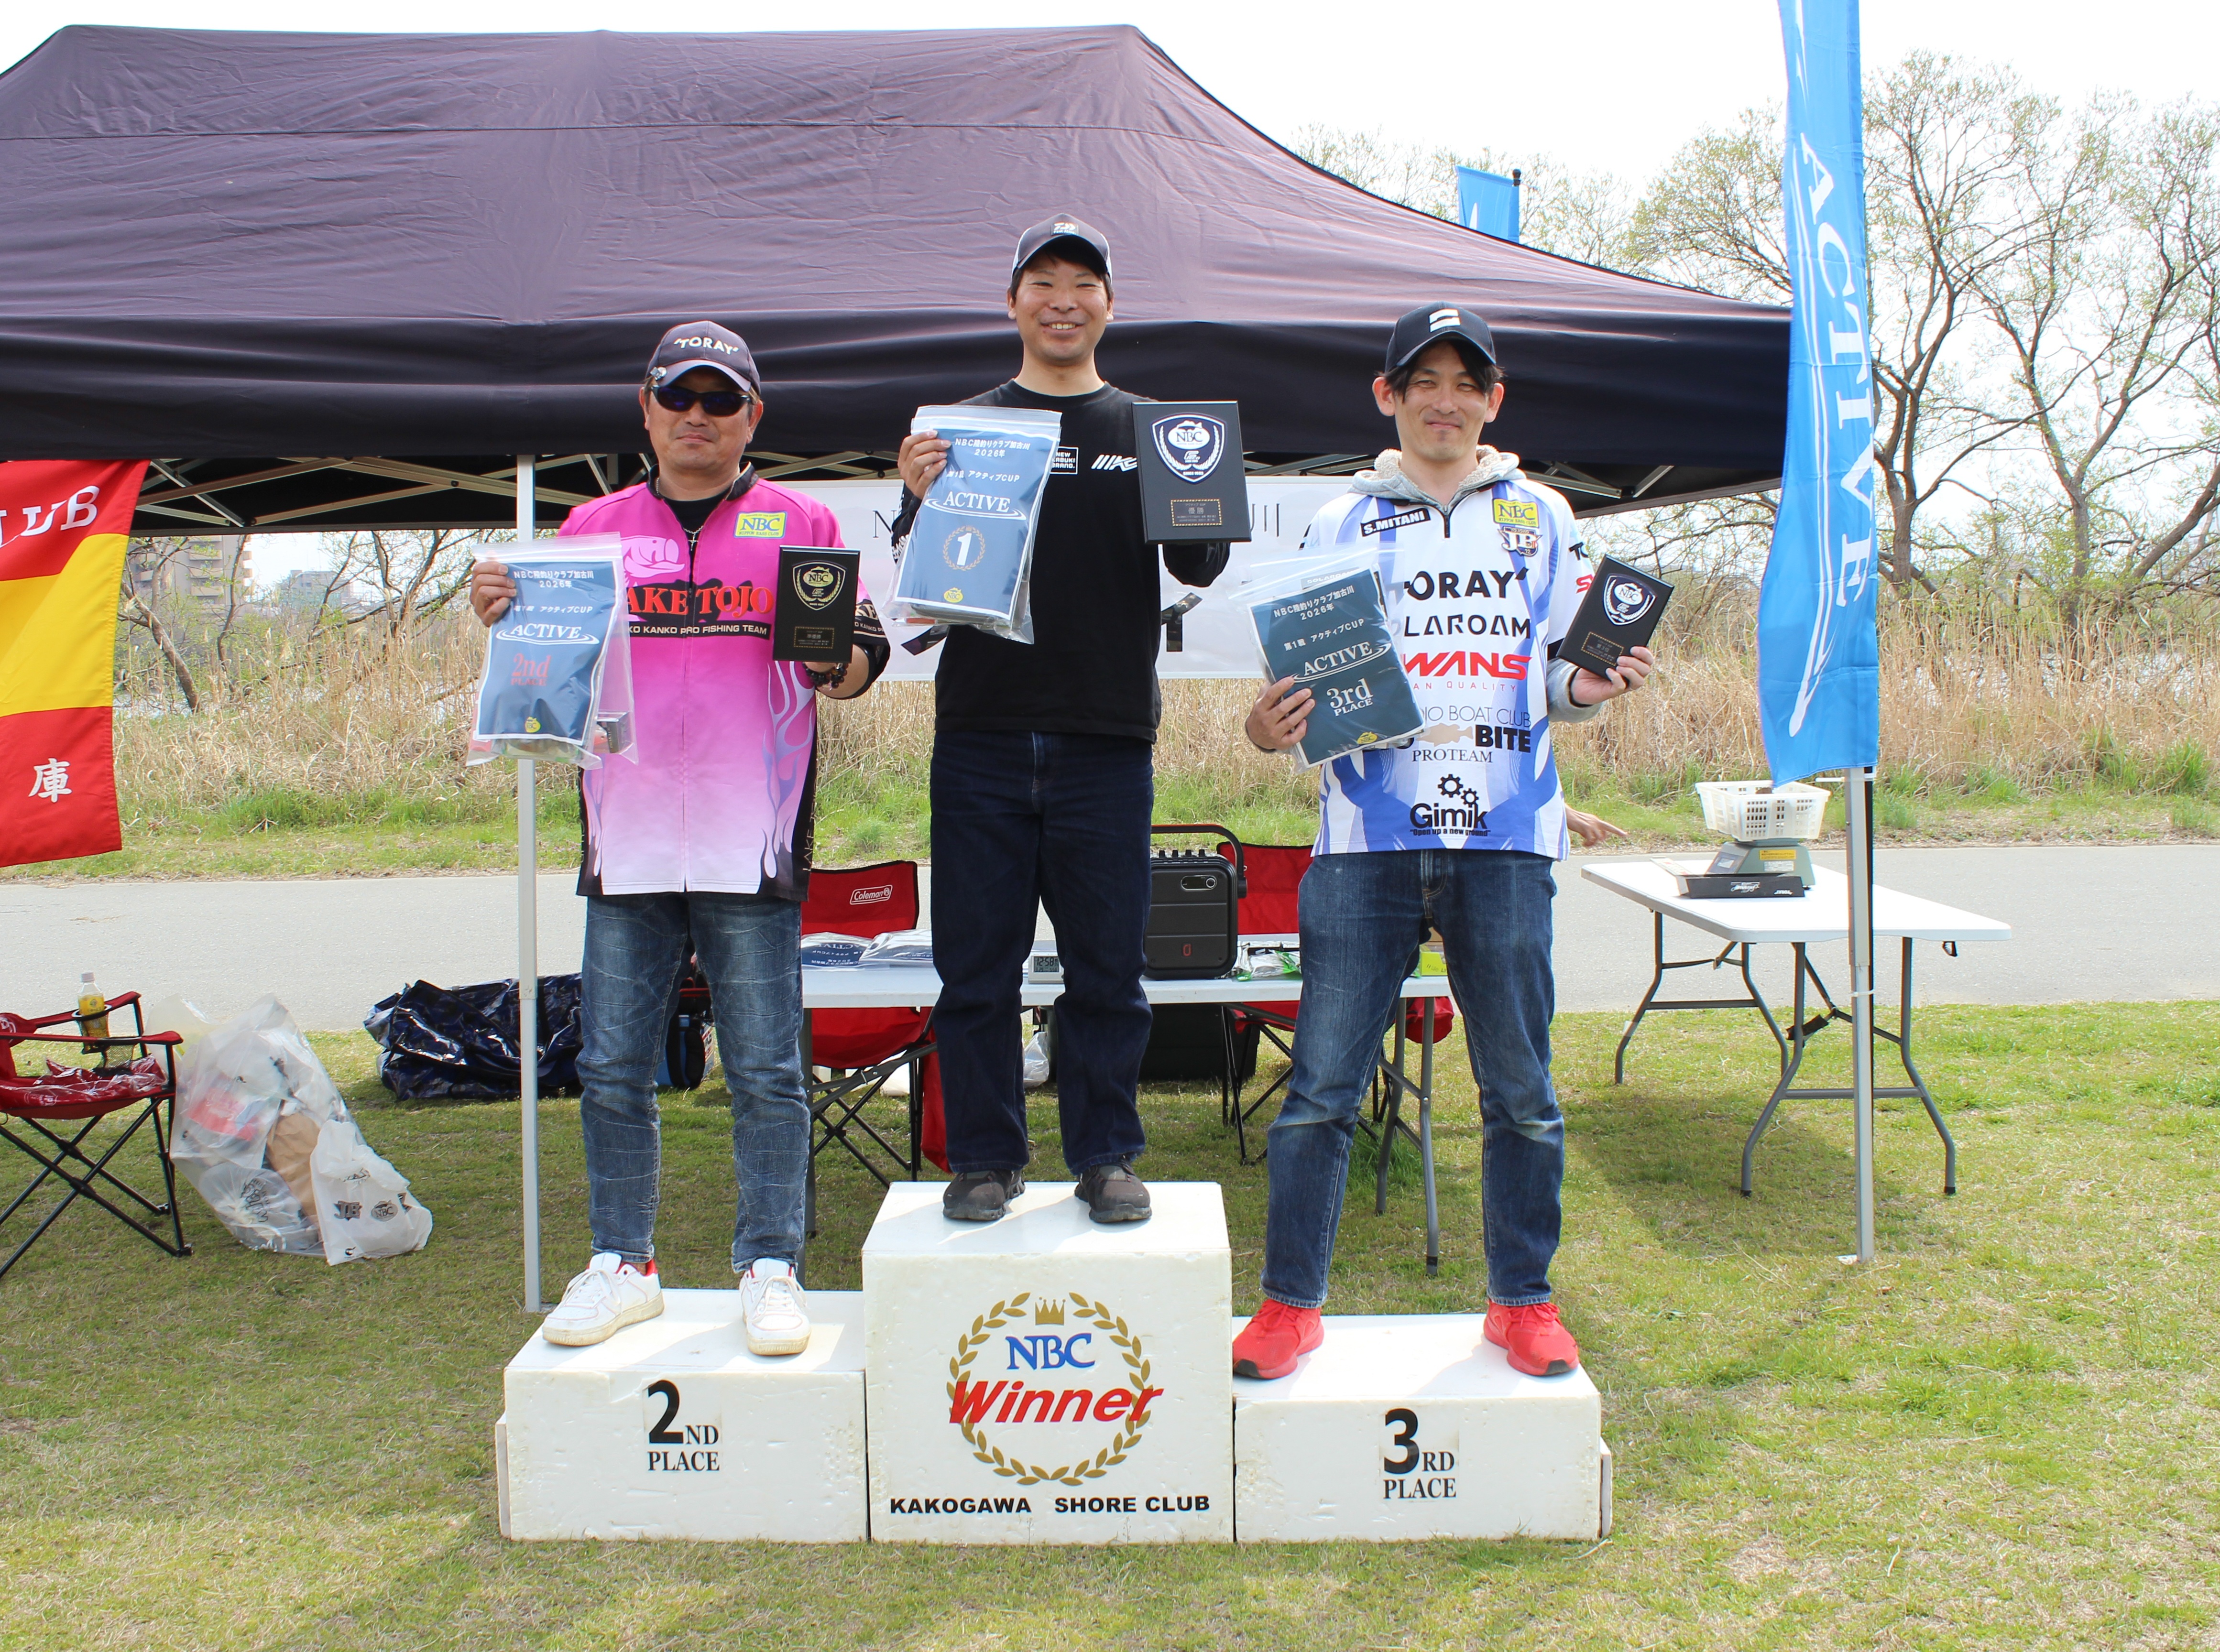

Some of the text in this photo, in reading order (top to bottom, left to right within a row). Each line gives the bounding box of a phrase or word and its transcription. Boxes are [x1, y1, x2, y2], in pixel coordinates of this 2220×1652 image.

[1800, 132, 1874, 608] ACTIVE
[955, 438, 1030, 450] NBC陸釣りクラブ加古川
[1176, 432, 1203, 442] NBC
[974, 449, 1005, 457] 2026年
[968, 470, 1020, 482] アクティブCUP
[943, 491, 1010, 513] ACTIVE
[1498, 504, 1535, 520] NBC
[740, 518, 780, 531] NBC
[1363, 511, 1425, 535] S.MITANI
[956, 533, 972, 565] 1
[809, 574, 829, 583] NBC
[627, 586, 774, 618] AKE TOJO
[1273, 586, 1355, 618] NBC陸釣りクラブ加古川
[1619, 587, 1639, 602] NBC
[855, 604, 878, 620] KE
[1300, 603, 1334, 620] 2026年
[510, 623, 581, 639] ACTIVE
[643, 626, 677, 634] KANKO
[680, 626, 700, 634] PRO
[702, 625, 740, 633] FISHING
[742, 625, 767, 635] TEAM
[1284, 619, 1365, 651] 第1戦 アクティブCUP
[512, 653, 551, 678] 2nd
[1303, 641, 1372, 676] ACTIVE
[1402, 651, 1532, 681] WANS
[511, 678, 547, 686] PLACE
[1446, 681, 1516, 692] QUALITY
[1326, 678, 1373, 709] 3rd
[1334, 698, 1373, 717] PLACE
[1449, 706, 1492, 722] BOAT
[1497, 708, 1531, 727] CLUB
[1476, 724, 1531, 753] BITE
[1412, 749, 1493, 763] PROTEAM
[28, 758, 72, 803] 庫
[1410, 803, 1488, 829] Gimik
[854, 891, 883, 901] Coleman
[1037, 957, 1054, 966] 12:58
[375, 1206, 394, 1217] NBC
[1006, 1333, 1095, 1369] NBC
[648, 1379, 719, 1445] 2ND
[949, 1380, 1164, 1424] Winner
[1384, 1408, 1454, 1474] 3RD
[648, 1451, 720, 1472] PLACE
[1383, 1478, 1457, 1499] PLACE
[890, 1496, 1210, 1514] KAKOGAWA SHORE CLUB
